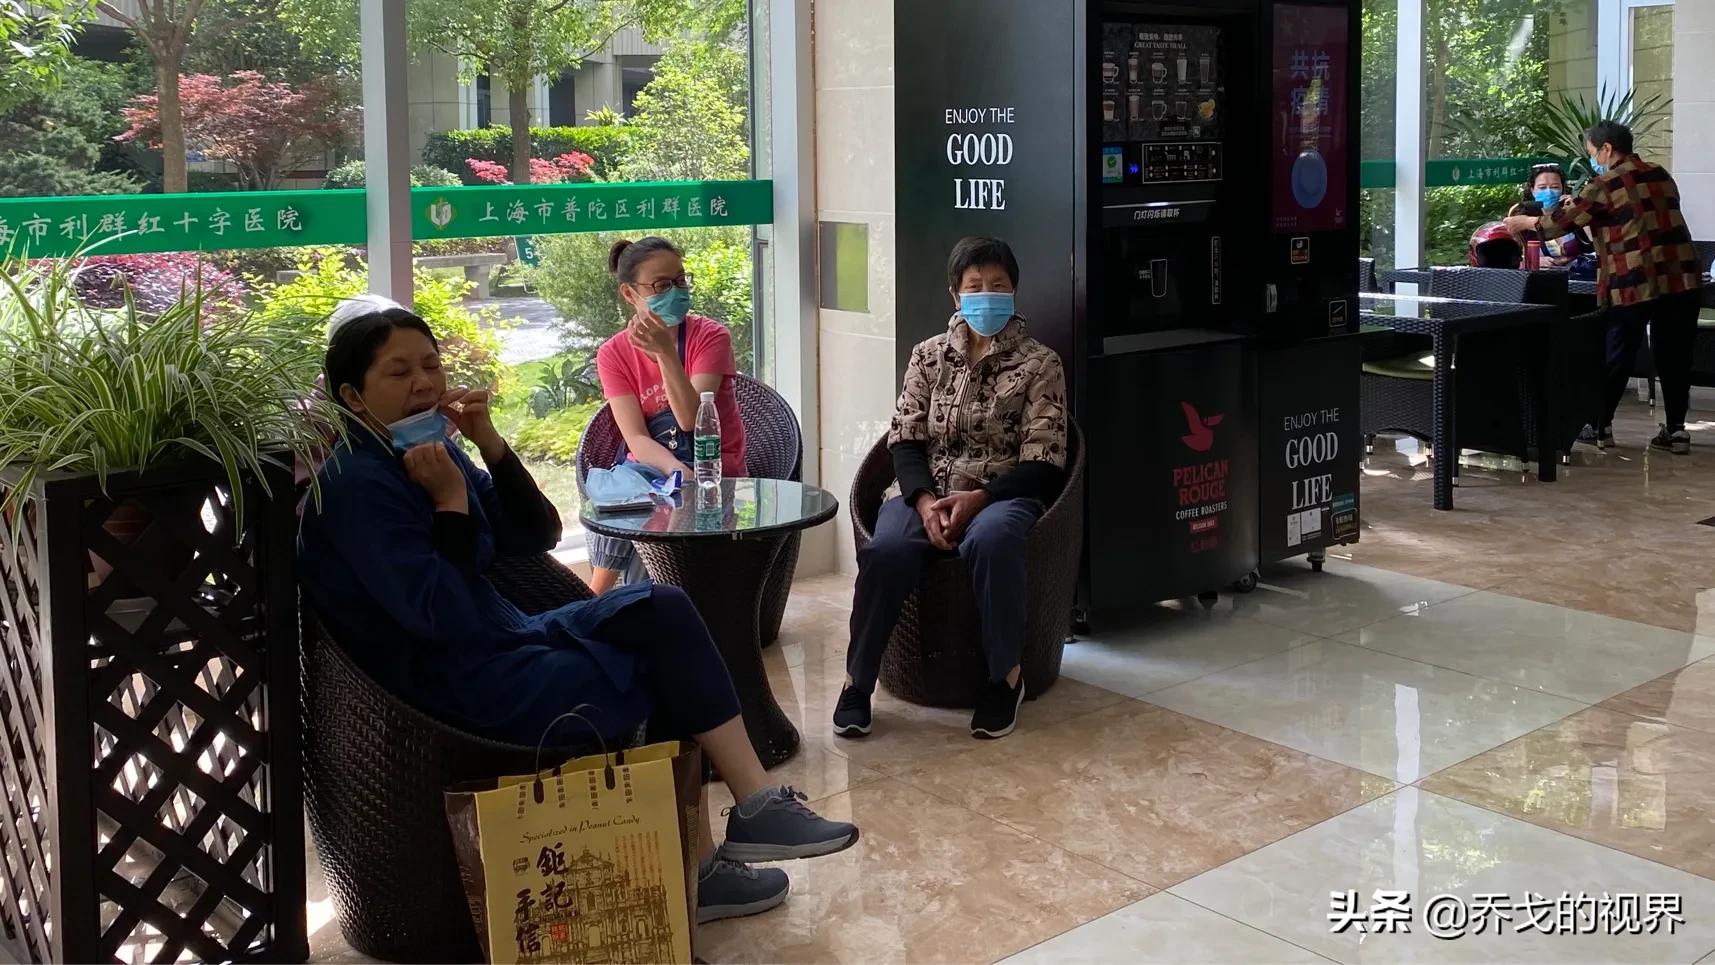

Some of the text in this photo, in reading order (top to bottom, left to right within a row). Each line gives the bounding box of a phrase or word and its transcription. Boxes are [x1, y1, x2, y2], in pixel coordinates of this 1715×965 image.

[945, 107, 1015, 124] ENJOY THE
[946, 133, 1014, 166] GOOD
[953, 178, 1006, 210] LIFE
[478, 195, 729, 225] 上海市普陀区利群医院
[1284, 407, 1340, 431] ENJOY THE
[1285, 432, 1339, 469] GOOD
[1172, 459, 1230, 487] PELICAN
[1178, 479, 1226, 505] ROUGE
[1291, 473, 1333, 510] LIFE
[1175, 500, 1228, 520] COFFEE ROASTERS
[519, 814, 640, 844] Specialized in Peanut Candy
[536, 841, 573, 912] 鉅記
